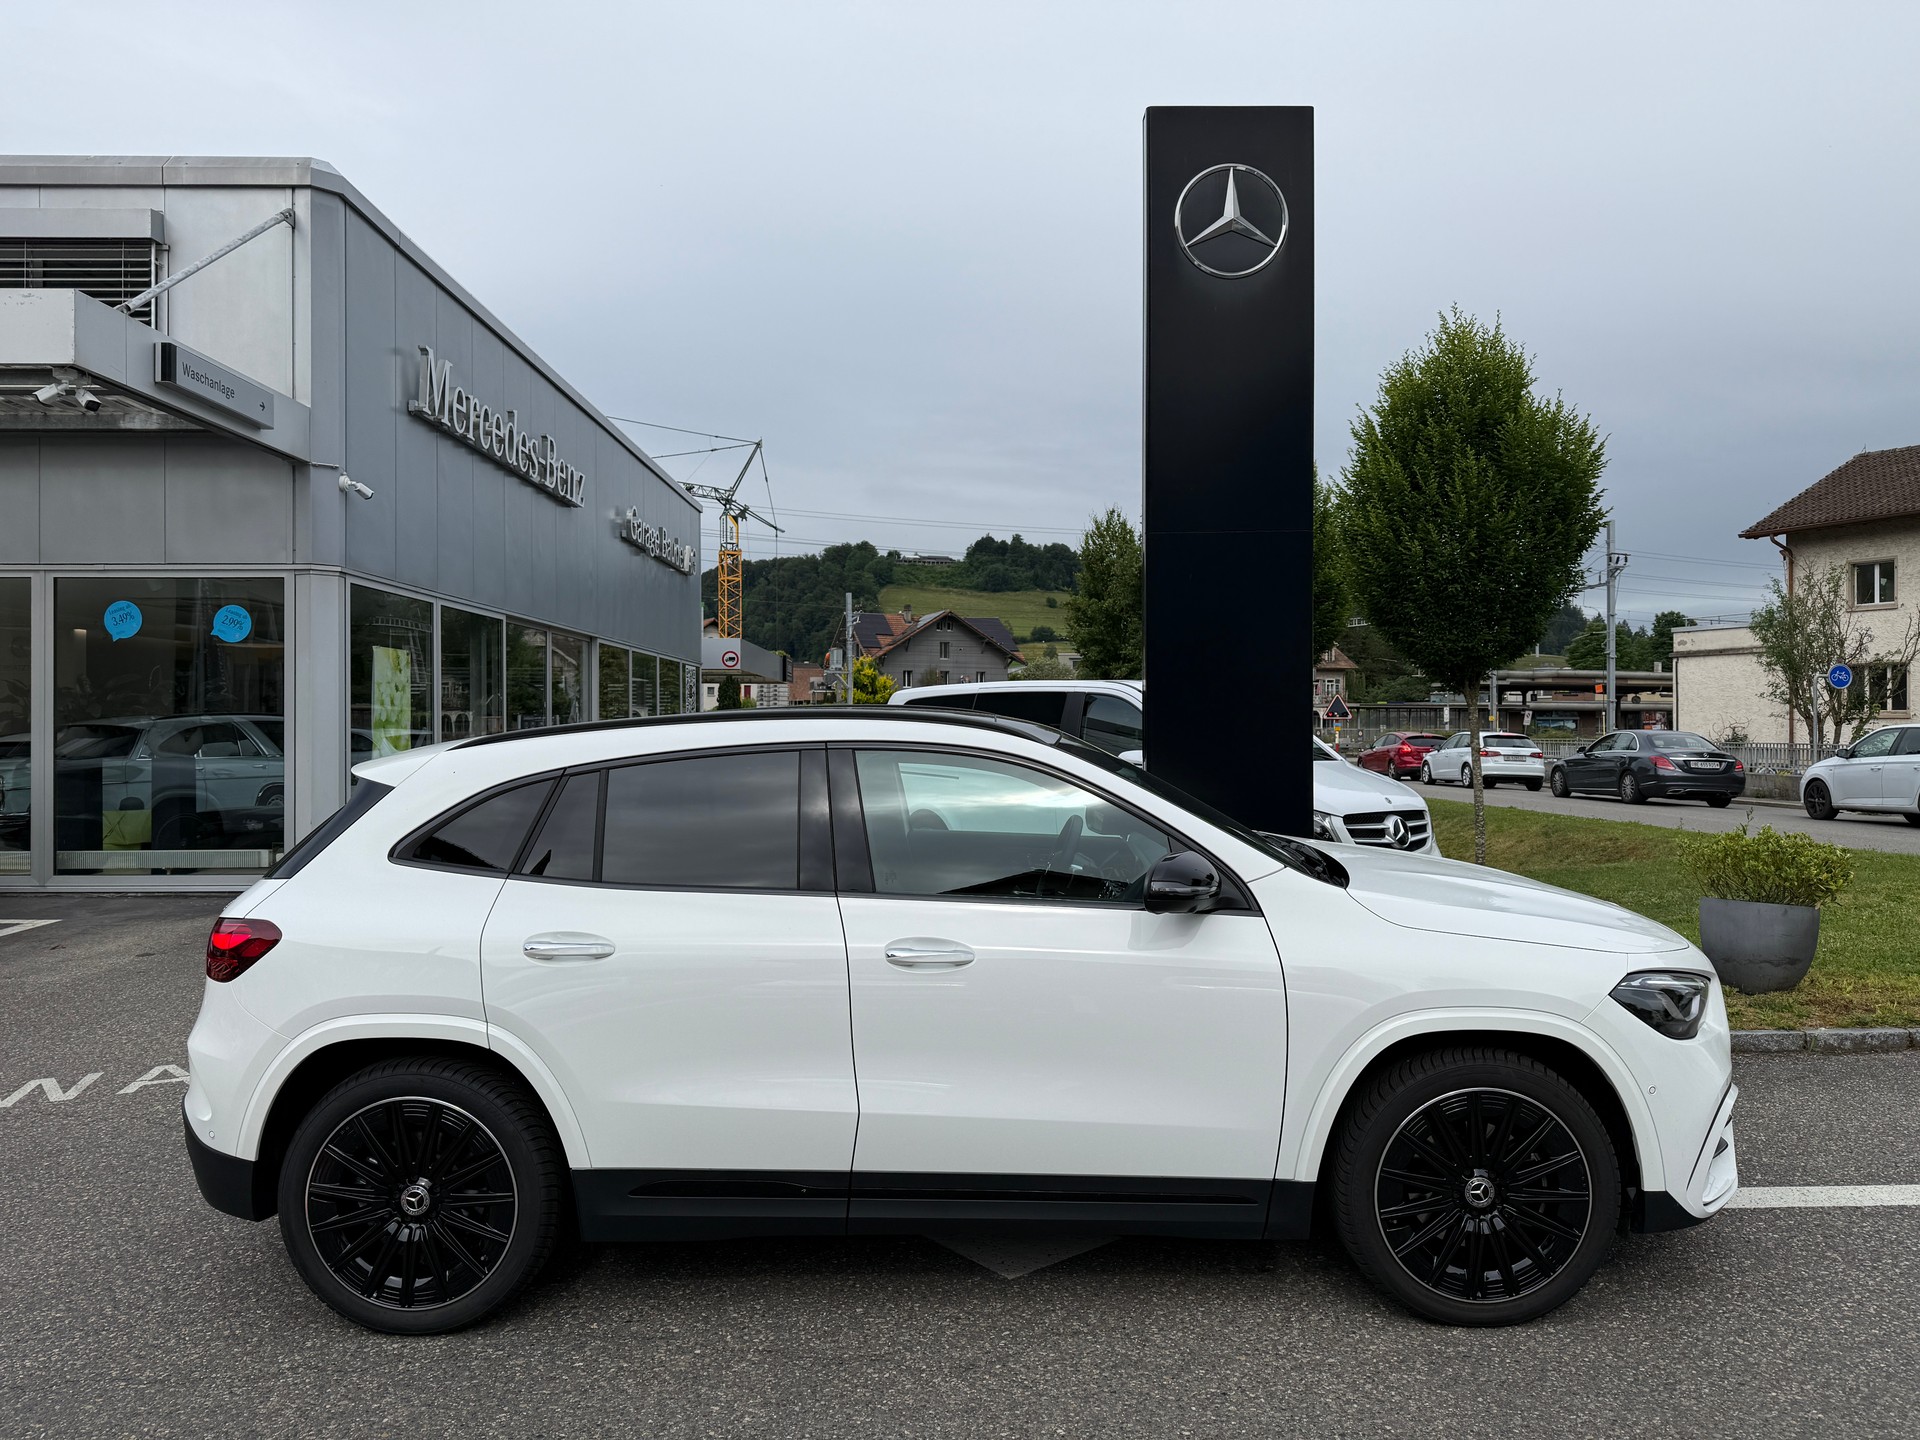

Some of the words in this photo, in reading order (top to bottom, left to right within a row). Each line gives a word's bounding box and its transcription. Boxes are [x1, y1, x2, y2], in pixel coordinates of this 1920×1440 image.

[182, 362, 236, 400] Waschanlage
[417, 345, 586, 508] Mercedes-Benz
[629, 505, 661, 557] Garage
[111, 611, 136, 627] 3.49%
[221, 614, 244, 631] 2.99%
